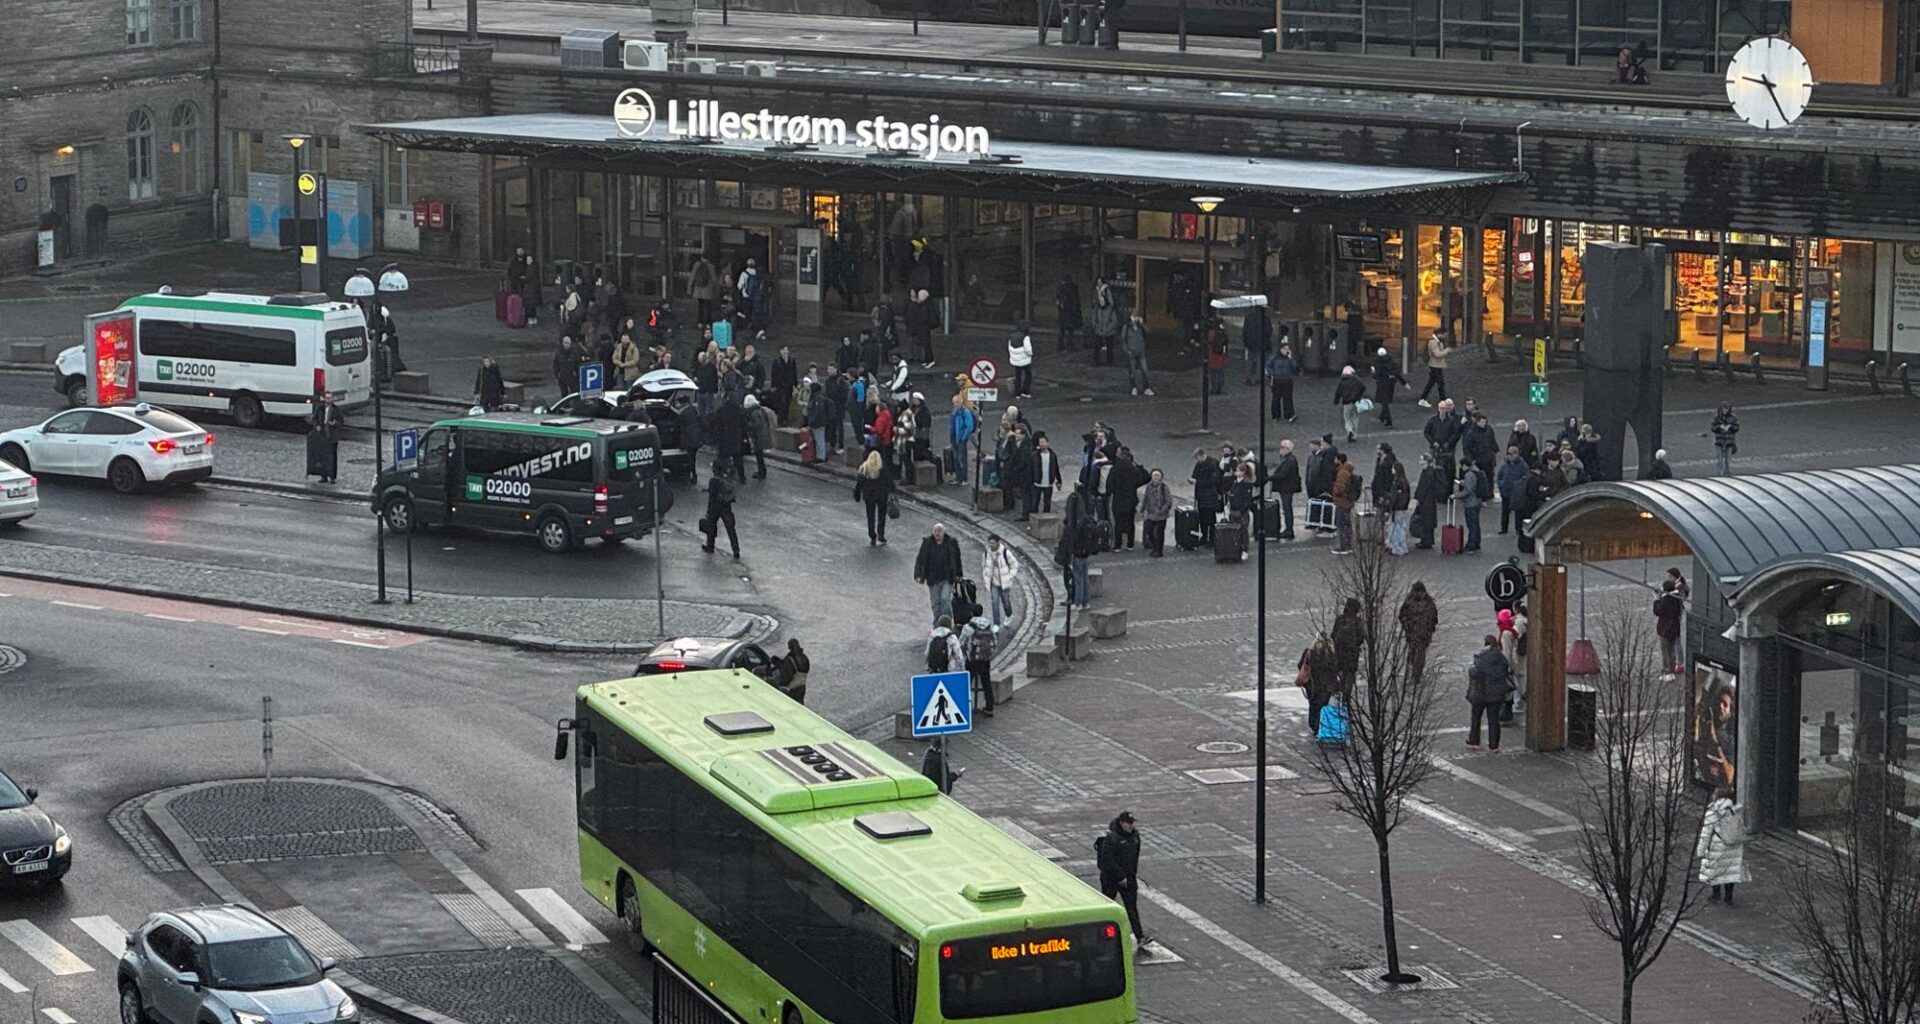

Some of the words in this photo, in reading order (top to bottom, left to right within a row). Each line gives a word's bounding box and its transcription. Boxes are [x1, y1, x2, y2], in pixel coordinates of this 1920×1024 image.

[667, 99, 847, 146] Lillestrøm
[854, 113, 990, 160] stasjon
[342, 336, 362, 349] 02000
[175, 361, 216, 377] 02000
[586, 369, 598, 388] P
[402, 436, 412, 457] P
[628, 447, 654, 462] 02000
[467, 482, 482, 493] TAXI
[486, 478, 531, 497] 02000
[1499, 572, 1514, 597] b
[1029, 939, 1070, 955] trafikk
